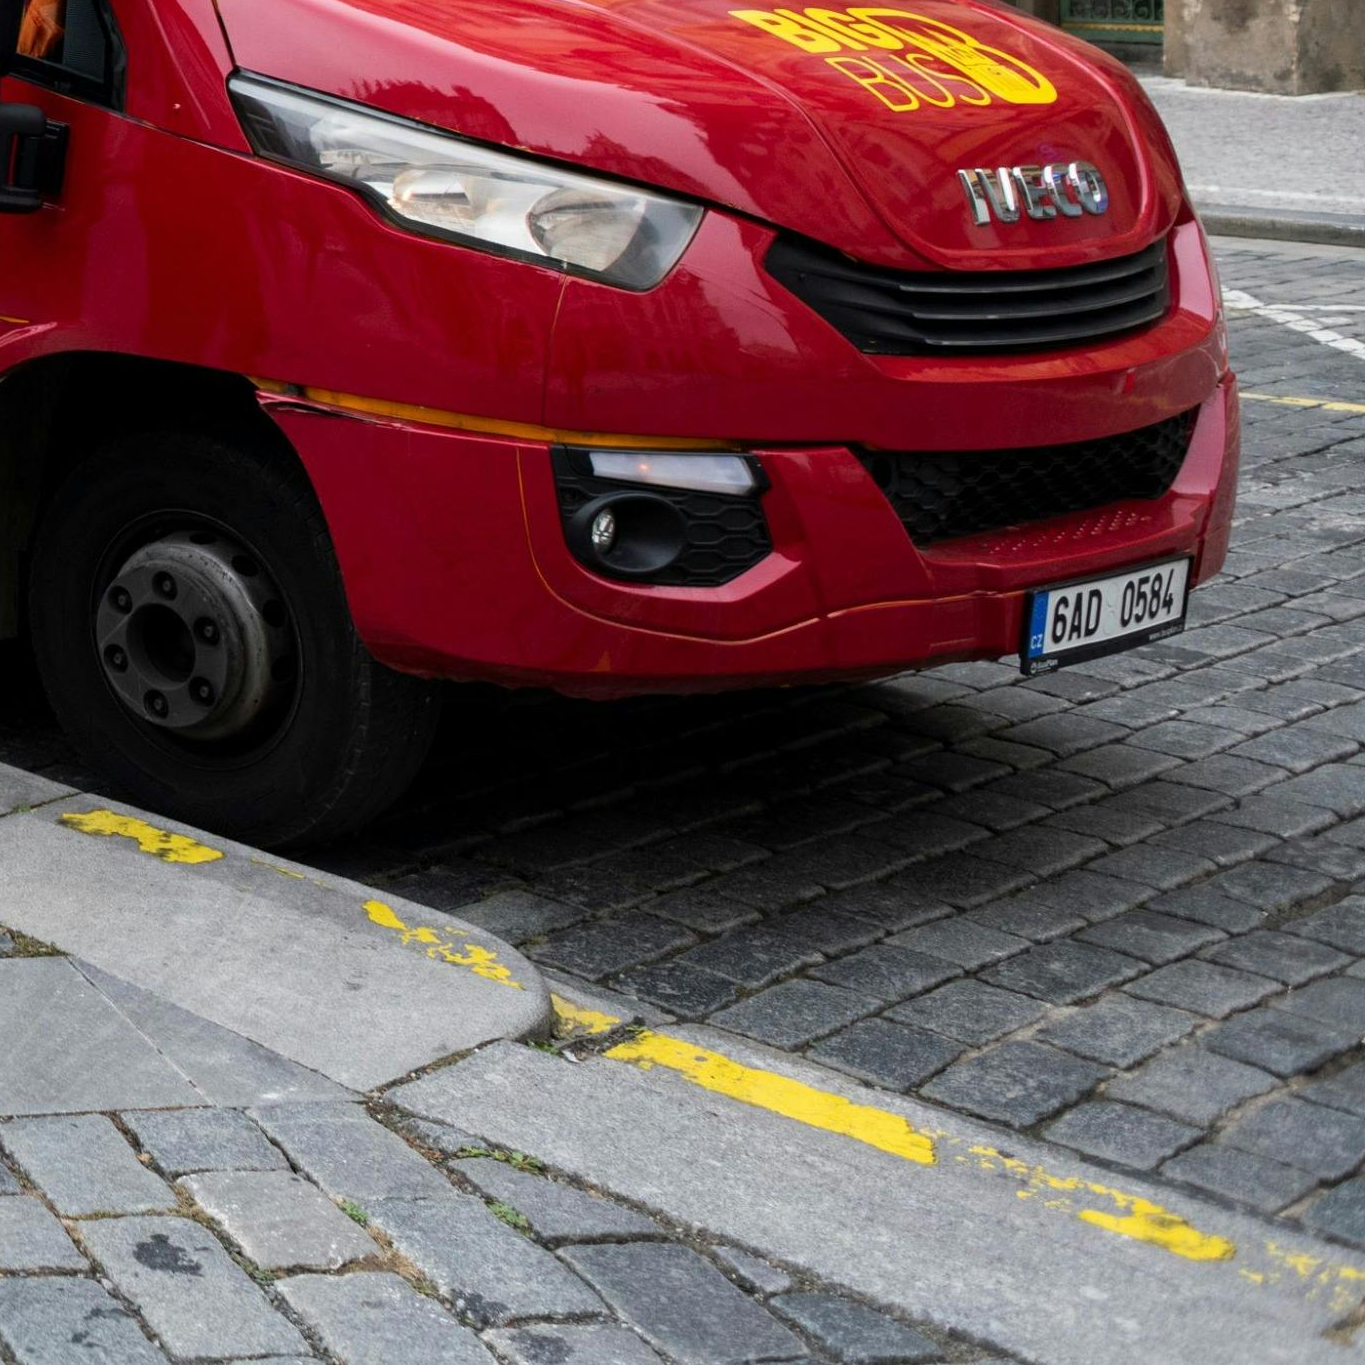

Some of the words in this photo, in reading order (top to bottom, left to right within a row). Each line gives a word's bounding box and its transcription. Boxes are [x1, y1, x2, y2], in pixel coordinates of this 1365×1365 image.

[727, 7, 905, 54] BIG
[824, 53, 992, 113] BUS
[956, 160, 1110, 226] IVECO
[1052, 588, 1103, 645] 6AD
[1120, 567, 1175, 628] 0584
[1029, 633, 1043, 650] CZ
